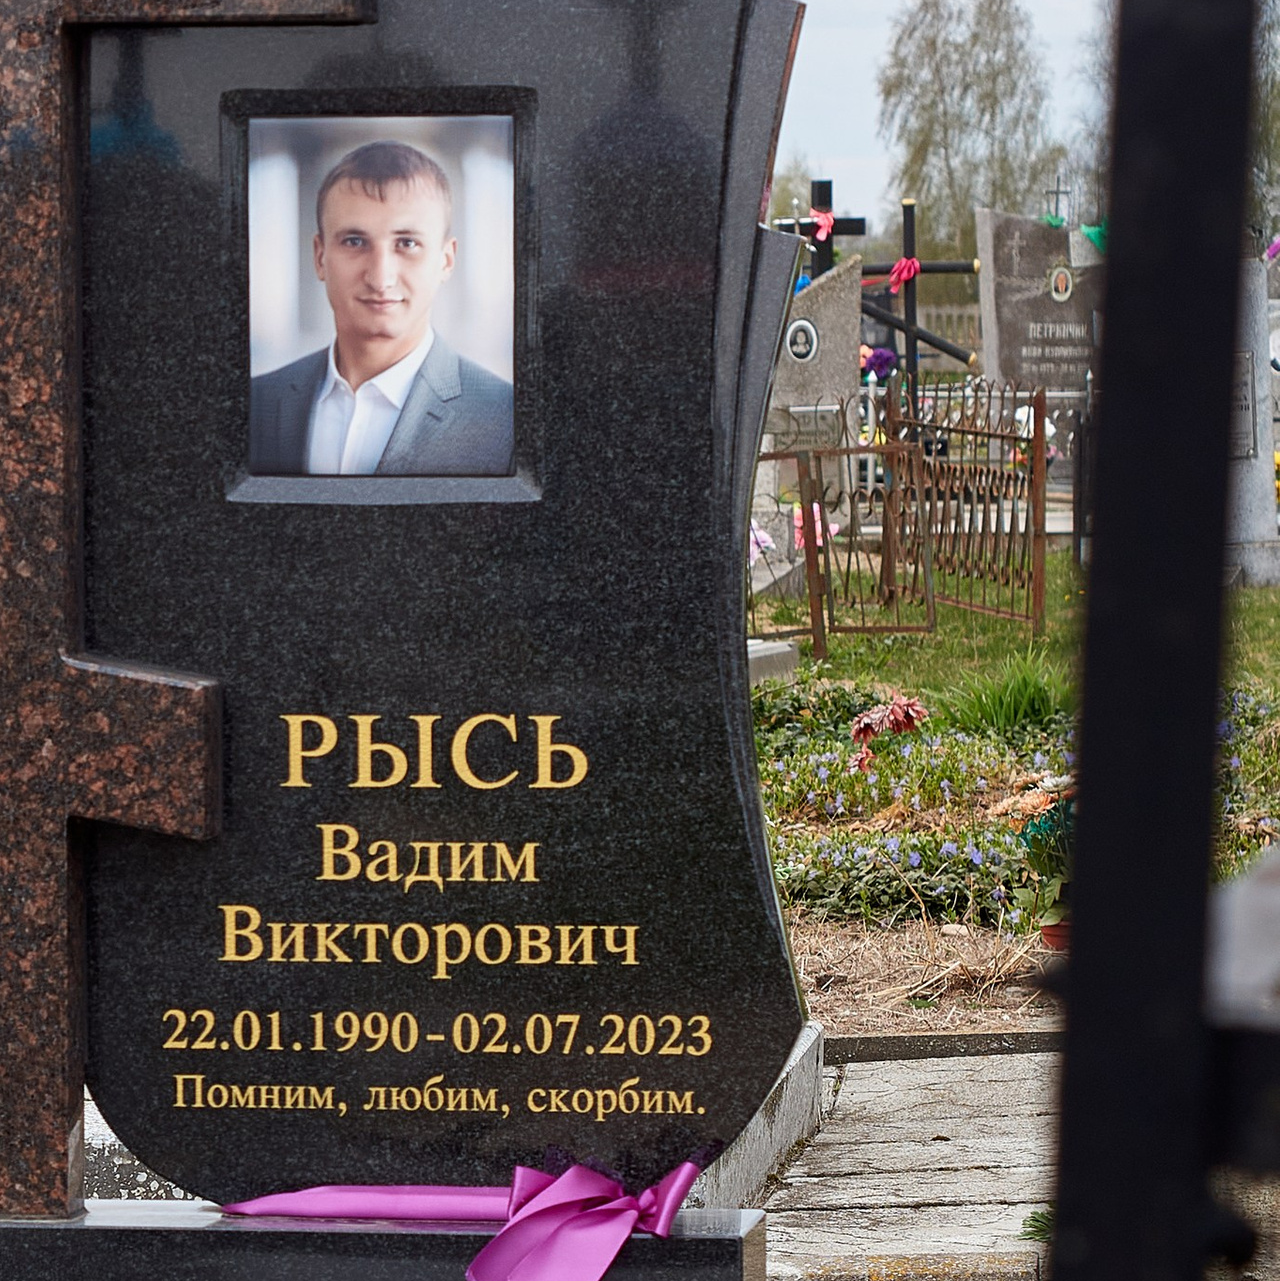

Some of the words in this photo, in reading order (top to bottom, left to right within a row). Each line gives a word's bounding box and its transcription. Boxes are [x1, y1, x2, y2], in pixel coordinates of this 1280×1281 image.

[279, 714, 589, 790] РЫСЬ
[315, 824, 540, 893] Вадим
[217, 905, 640, 981] Викторович
[173, 1075, 348, 1118] Помним,
[363, 1075, 511, 1120] любим,
[528, 1077, 707, 1123] скорбим.
